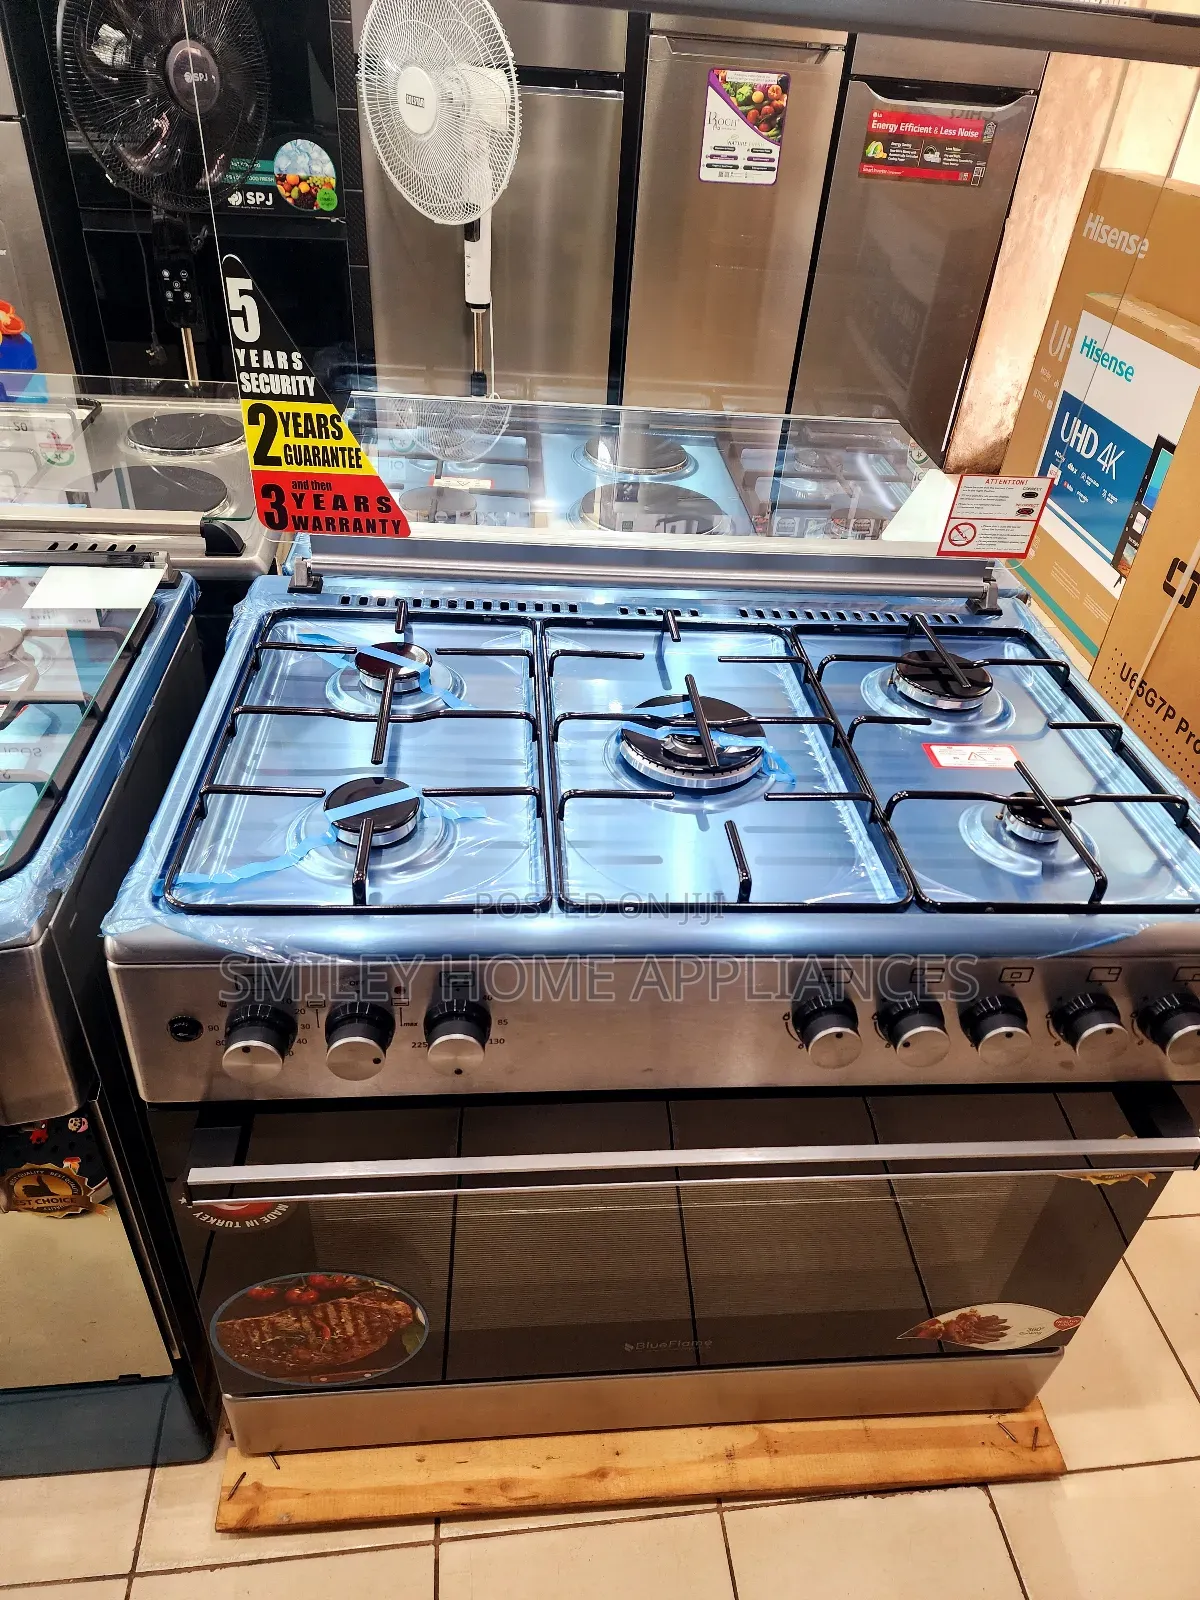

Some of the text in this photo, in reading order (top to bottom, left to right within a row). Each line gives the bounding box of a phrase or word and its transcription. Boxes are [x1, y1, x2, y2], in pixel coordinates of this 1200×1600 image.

[193, 73, 208, 82] SPJ
[871, 120, 898, 133] Energy
[900, 122, 932, 134] Efficient
[933, 126, 939, 134] &
[940, 127, 957, 136] Less
[958, 128, 979, 138] Noise
[246, 191, 274, 207] SPJ
[1082, 212, 1150, 260] Hisense
[225, 276, 261, 343] 5
[235, 348, 304, 371] YEARS
[1079, 335, 1135, 383] Hisense
[239, 371, 316, 397] SECURITY
[247, 402, 283, 467] 2
[278, 411, 344, 441] YEARS
[283, 443, 363, 469] GUARANTEE
[1060, 411, 1126, 480] UHD 4K
[291, 480, 332, 491] and then
[985, 478, 1029, 486] ATTENTION!
[260, 483, 289, 531] 3
[291, 492, 392, 514] YEARS
[291, 514, 402, 535] WARRANTY
[1119, 661, 1177, 723] U65G7P
[207, 1024, 220, 1033] 90
[411, 1041, 428, 1049] 225
[489, 1037, 506, 1045] 130
[34, 1197, 77, 1205] CHOICE
[193, 1203, 290, 1228] MADE IN TURKEY
[635, 1339, 713, 1350] BlueFlame
